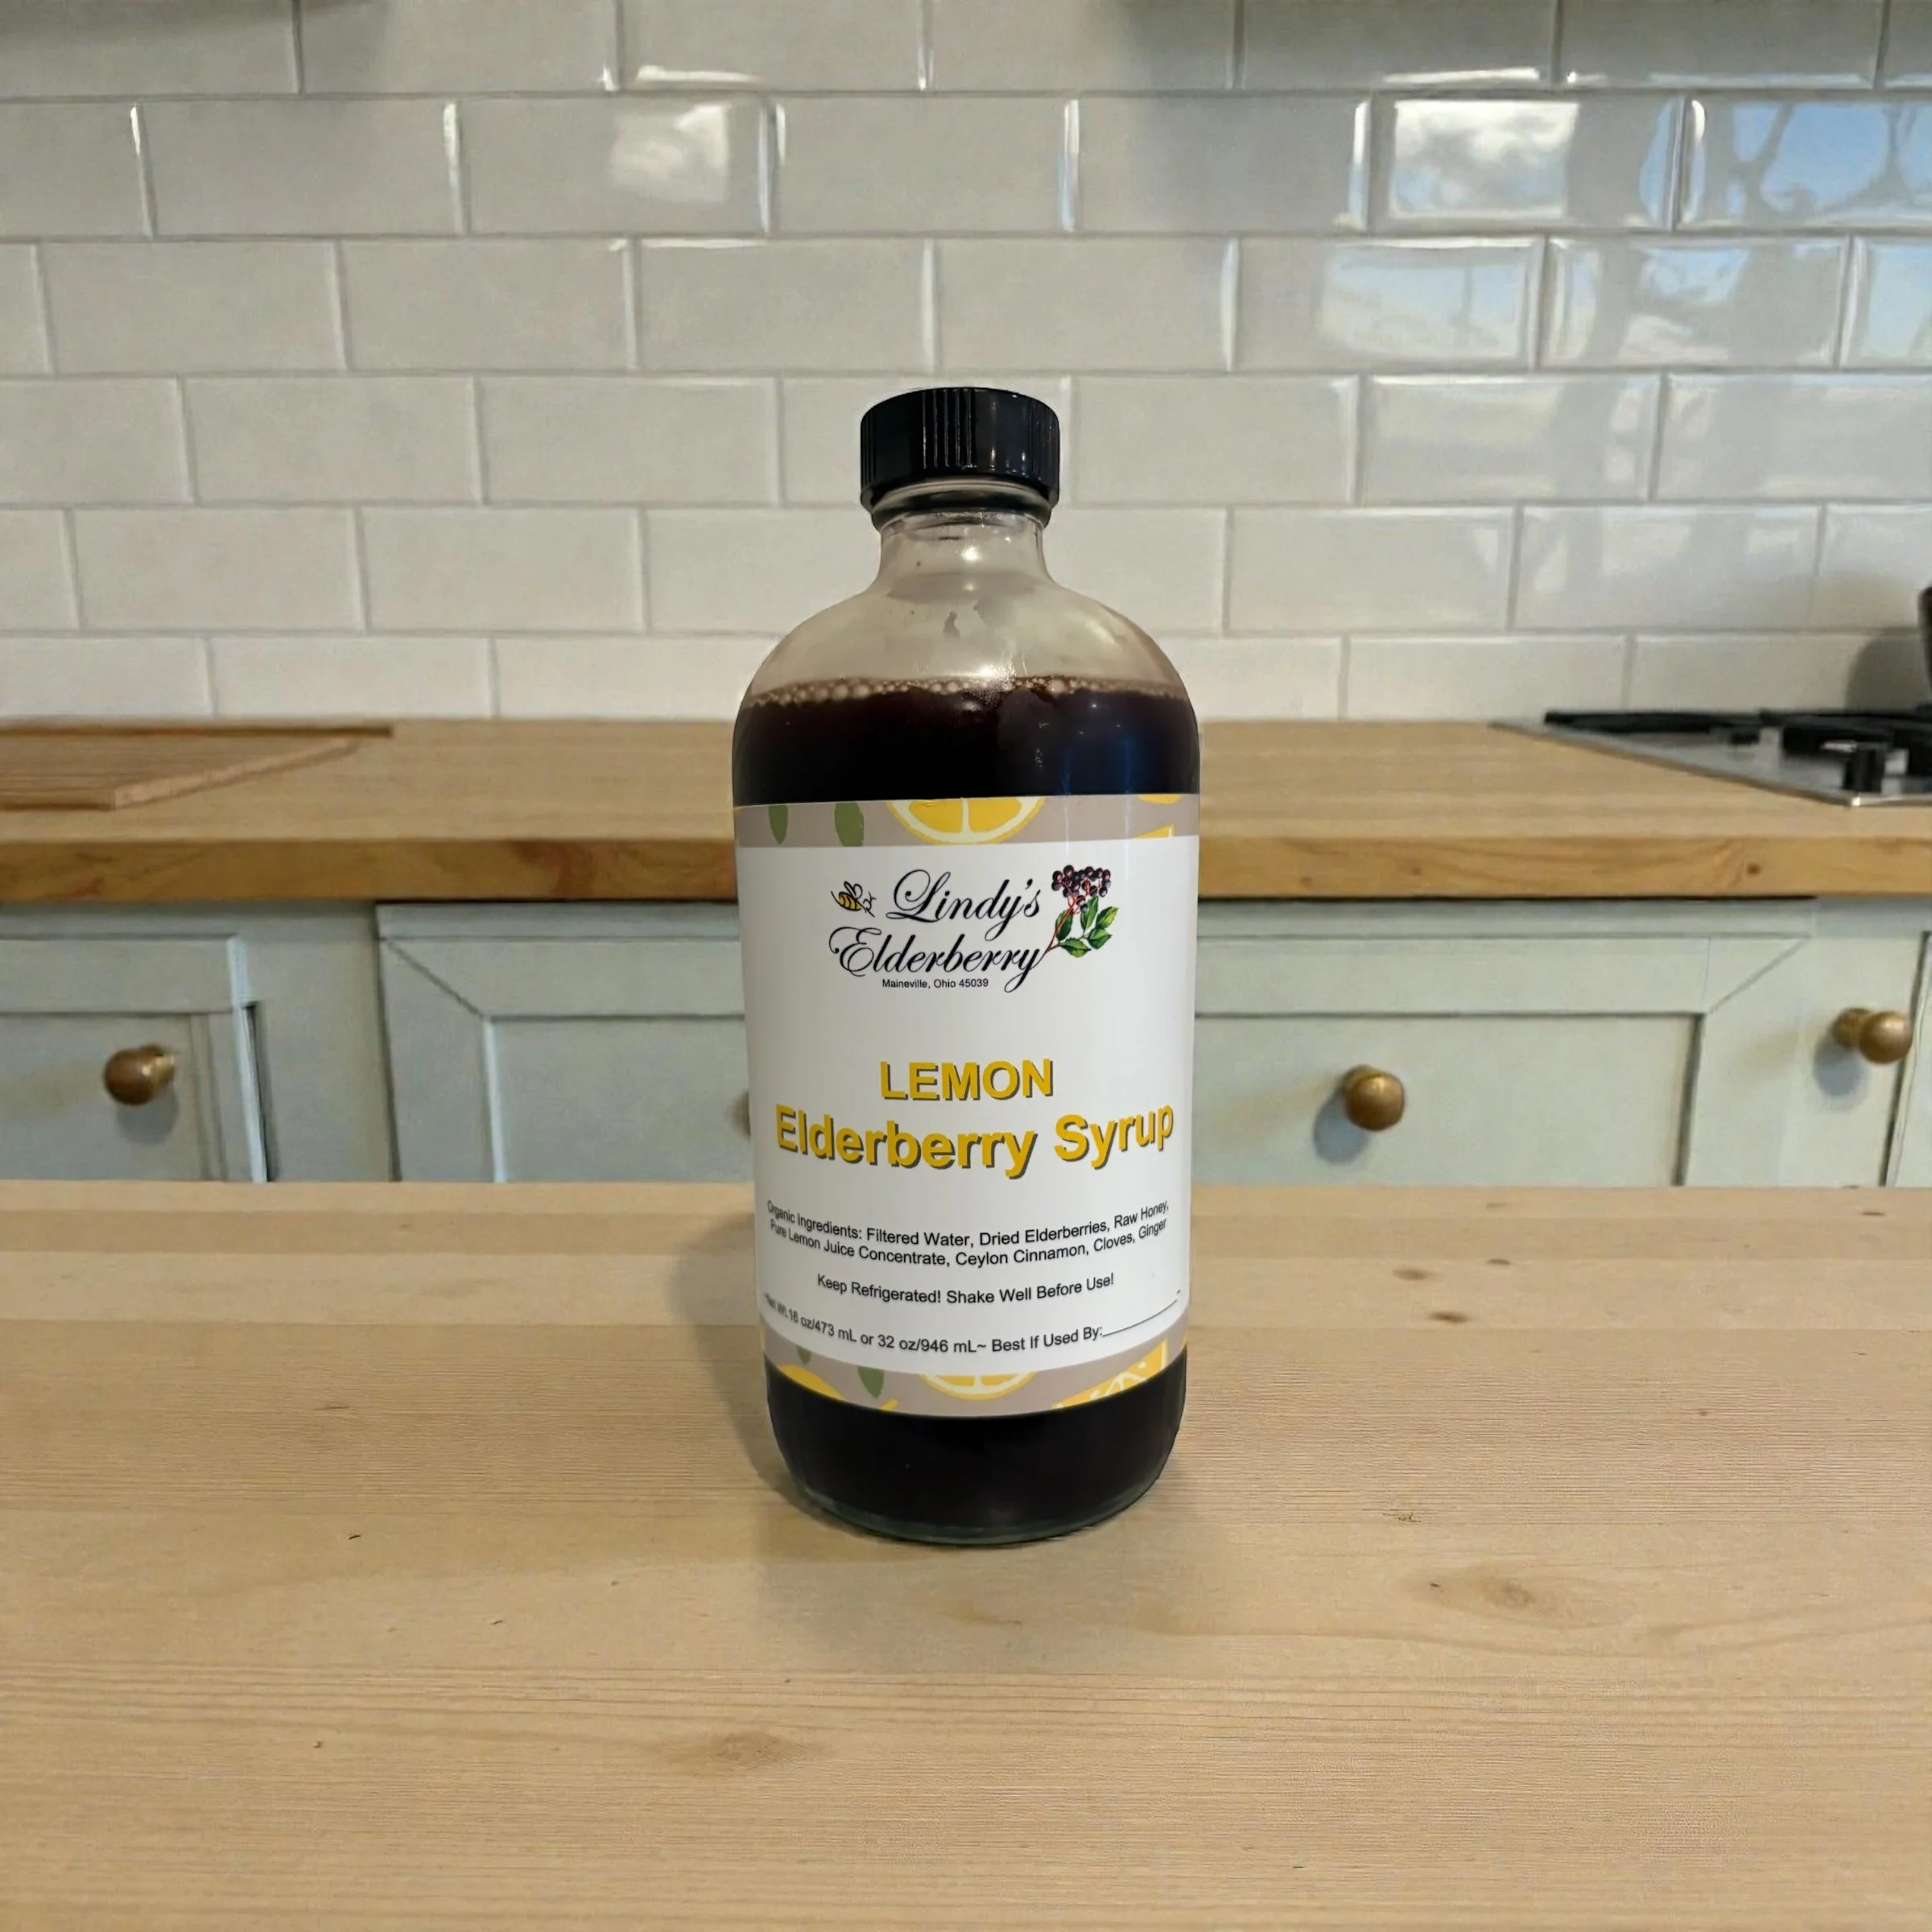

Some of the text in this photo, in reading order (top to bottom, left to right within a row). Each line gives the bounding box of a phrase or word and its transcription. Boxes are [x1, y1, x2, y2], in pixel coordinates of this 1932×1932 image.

[886, 869, 1040, 941] Lindy's
[828, 927, 1048, 993] Elderberry
[882, 978, 989, 989] Maineville, Ohio 45039
[880, 1058, 1054, 1101] LEMON
[775, 1104, 1174, 1180] Elderberry Syrup
[767, 1199, 795, 1223] Organic
[798, 1213, 862, 1239] Ingredients:
[867, 1228, 919, 1245] Filtered
[923, 1232, 974, 1248] Water,
[980, 1232, 1019, 1245] Dried
[1025, 1220, 1110, 1242] Elderberries,
[1114, 1213, 1138, 1228] Raw
[770, 1218, 1166, 1269] Pure Lemon Juice Concentrate, Ceylon Cinnamon, Cloves, Ginger
[817, 1272, 1114, 1304] Keep Refrigerated! Shake Well Before Use!
[800, 1317, 835, 1336] oz/473
[838, 1329, 857, 1343] mL
[861, 1335, 873, 1345] or
[877, 1335, 895, 1348] 32
[899, 1339, 948, 1352] oz/946
[992, 1339, 1026, 1352] Best
[1030, 1335, 1039, 1349] If
[1043, 1329, 1079, 1348] Used
